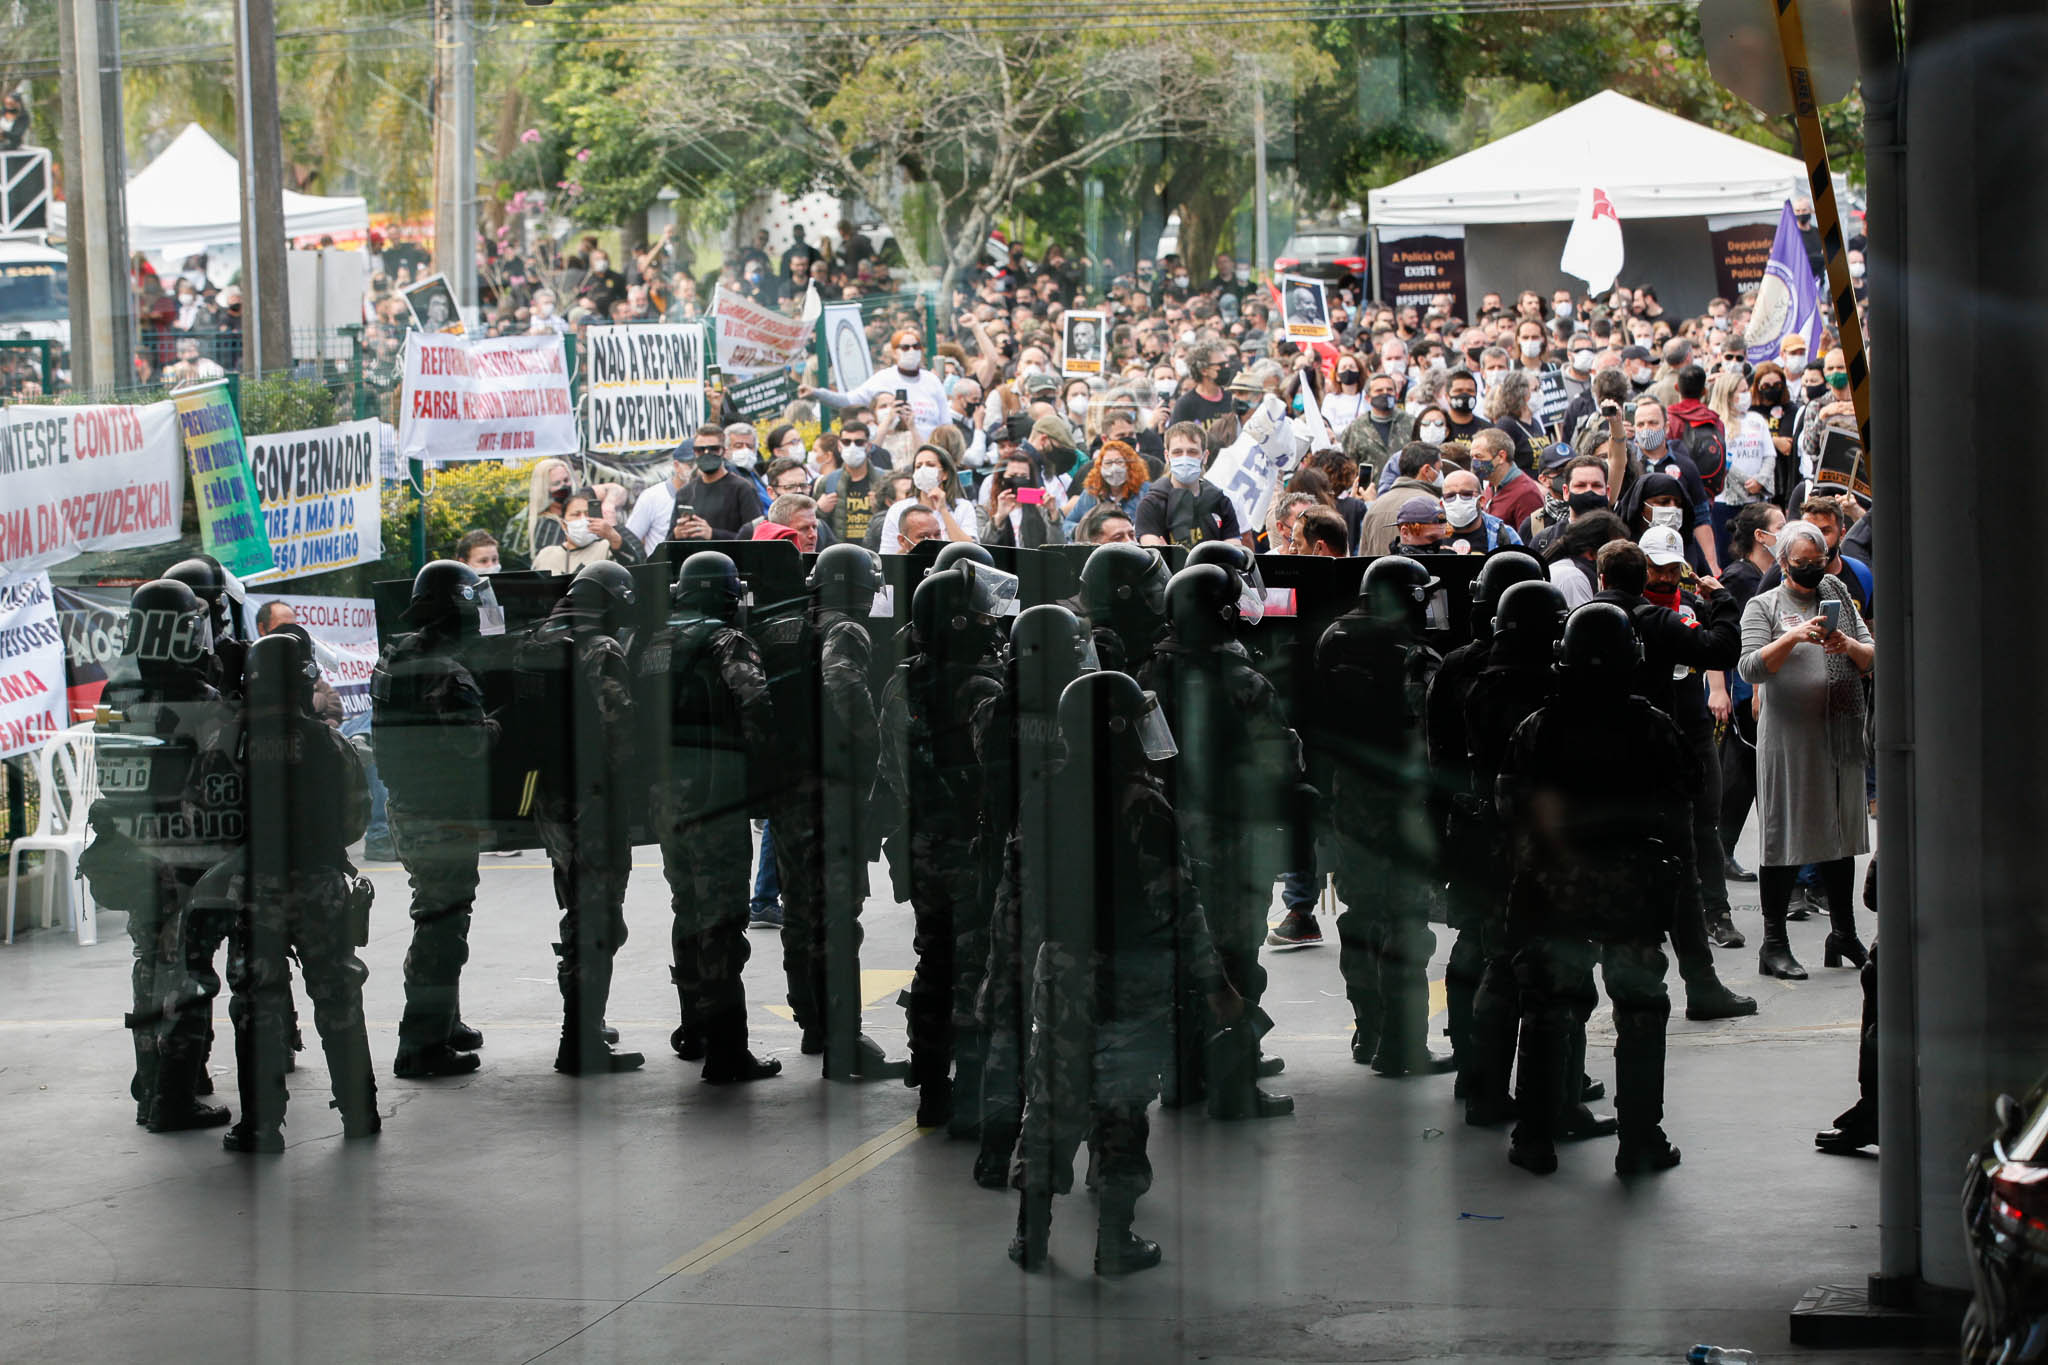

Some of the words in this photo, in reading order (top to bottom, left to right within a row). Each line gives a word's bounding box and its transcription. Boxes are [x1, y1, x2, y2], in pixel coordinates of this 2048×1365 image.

[1401, 250, 1433, 263] Polícia
[1433, 249, 1456, 262] Civil
[1404, 265, 1437, 278] EXISTE
[412, 389, 462, 422] FARSA,
[595, 398, 617, 444] DA
[73, 406, 144, 461] CONTRA
[252, 431, 373, 503] GOVERNADOR
[37, 502, 60, 555] DA
[59, 478, 173, 548] PREVIDÊNCIA
[290, 507, 301, 535] A
[305, 493, 336, 532] MÃO
[338, 496, 356, 526] DO
[301, 532, 359, 567] DINHEIRO
[342, 601, 350, 627] É
